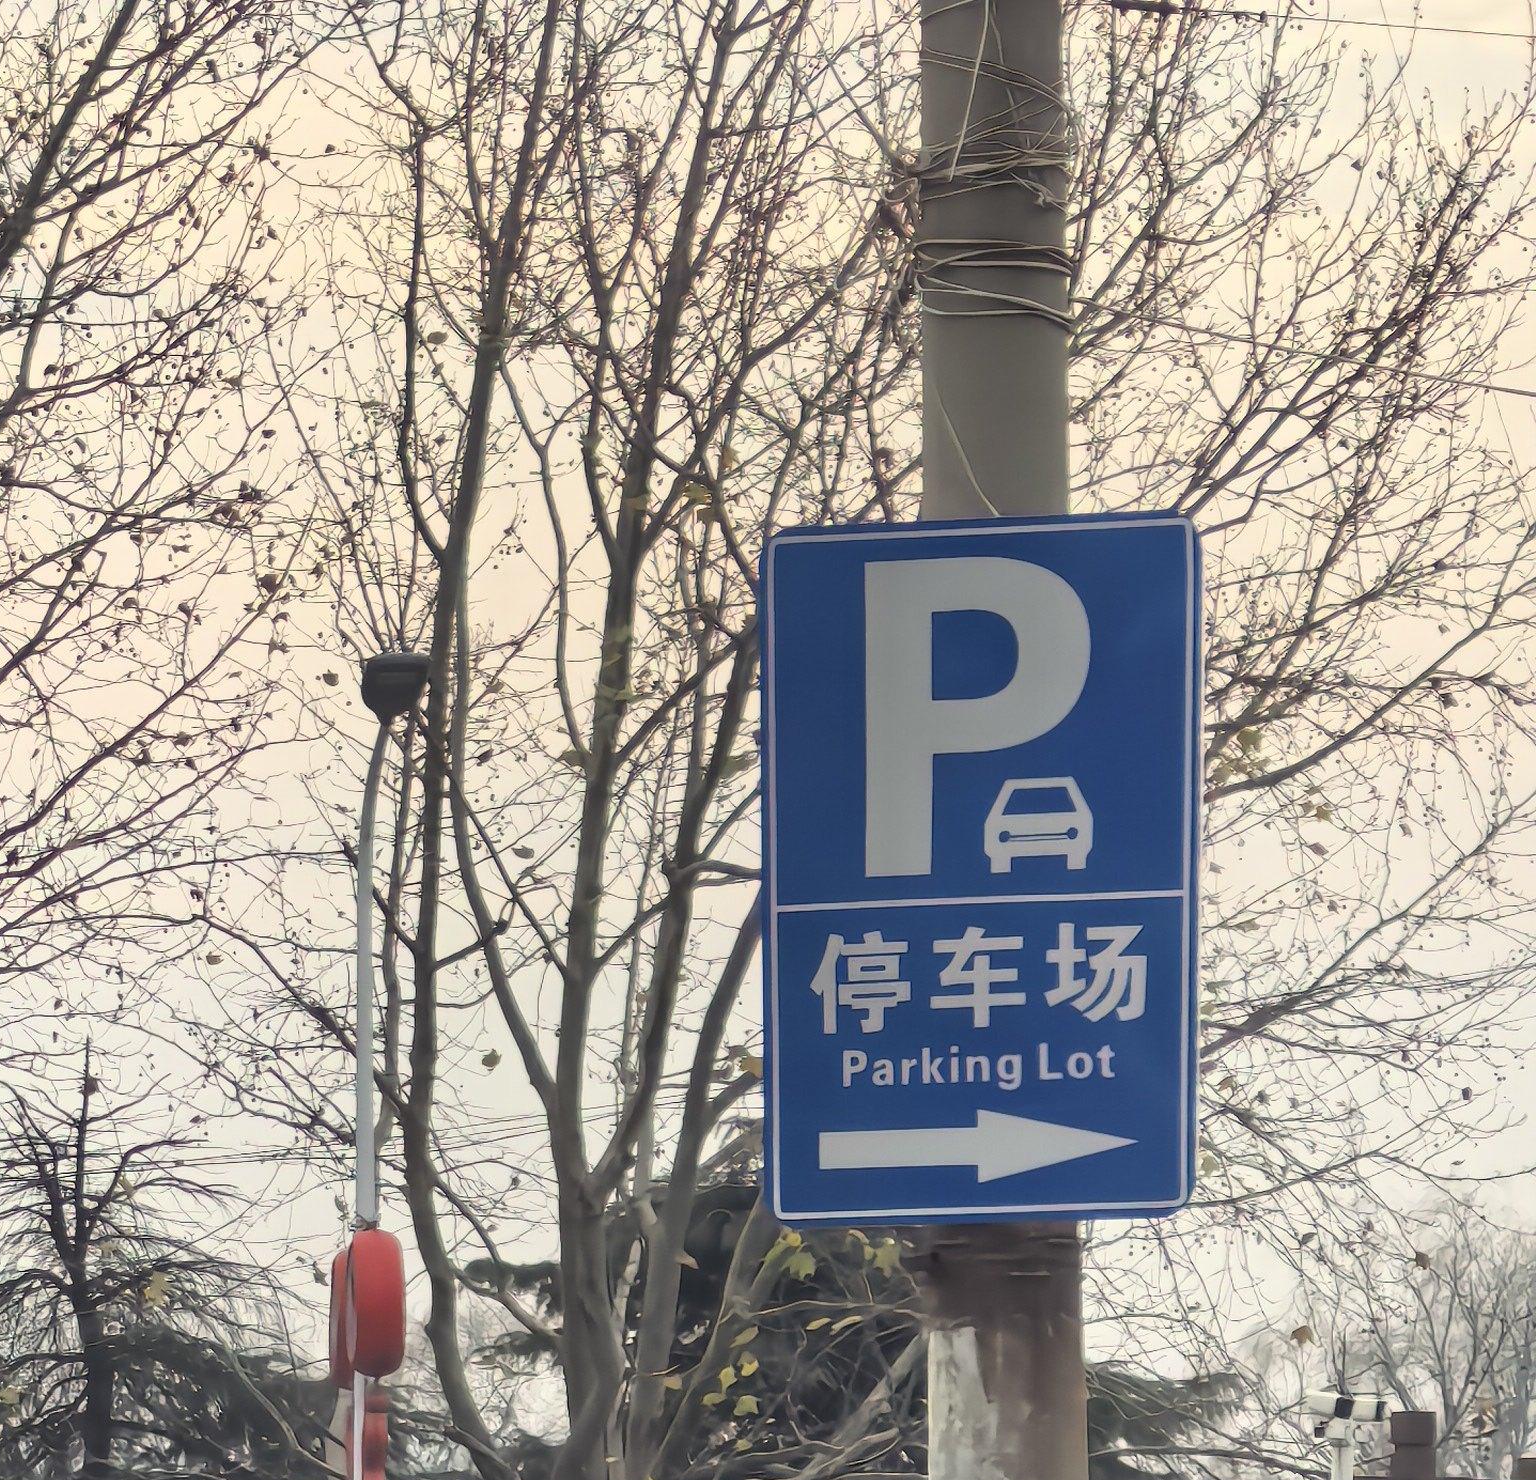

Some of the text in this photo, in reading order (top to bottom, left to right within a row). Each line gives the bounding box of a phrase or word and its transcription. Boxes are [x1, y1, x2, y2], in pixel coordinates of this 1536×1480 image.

[864, 556, 1091, 878] P
[810, 922, 1148, 1034] 停车场
[842, 1042, 1115, 1090] Parking Lot
